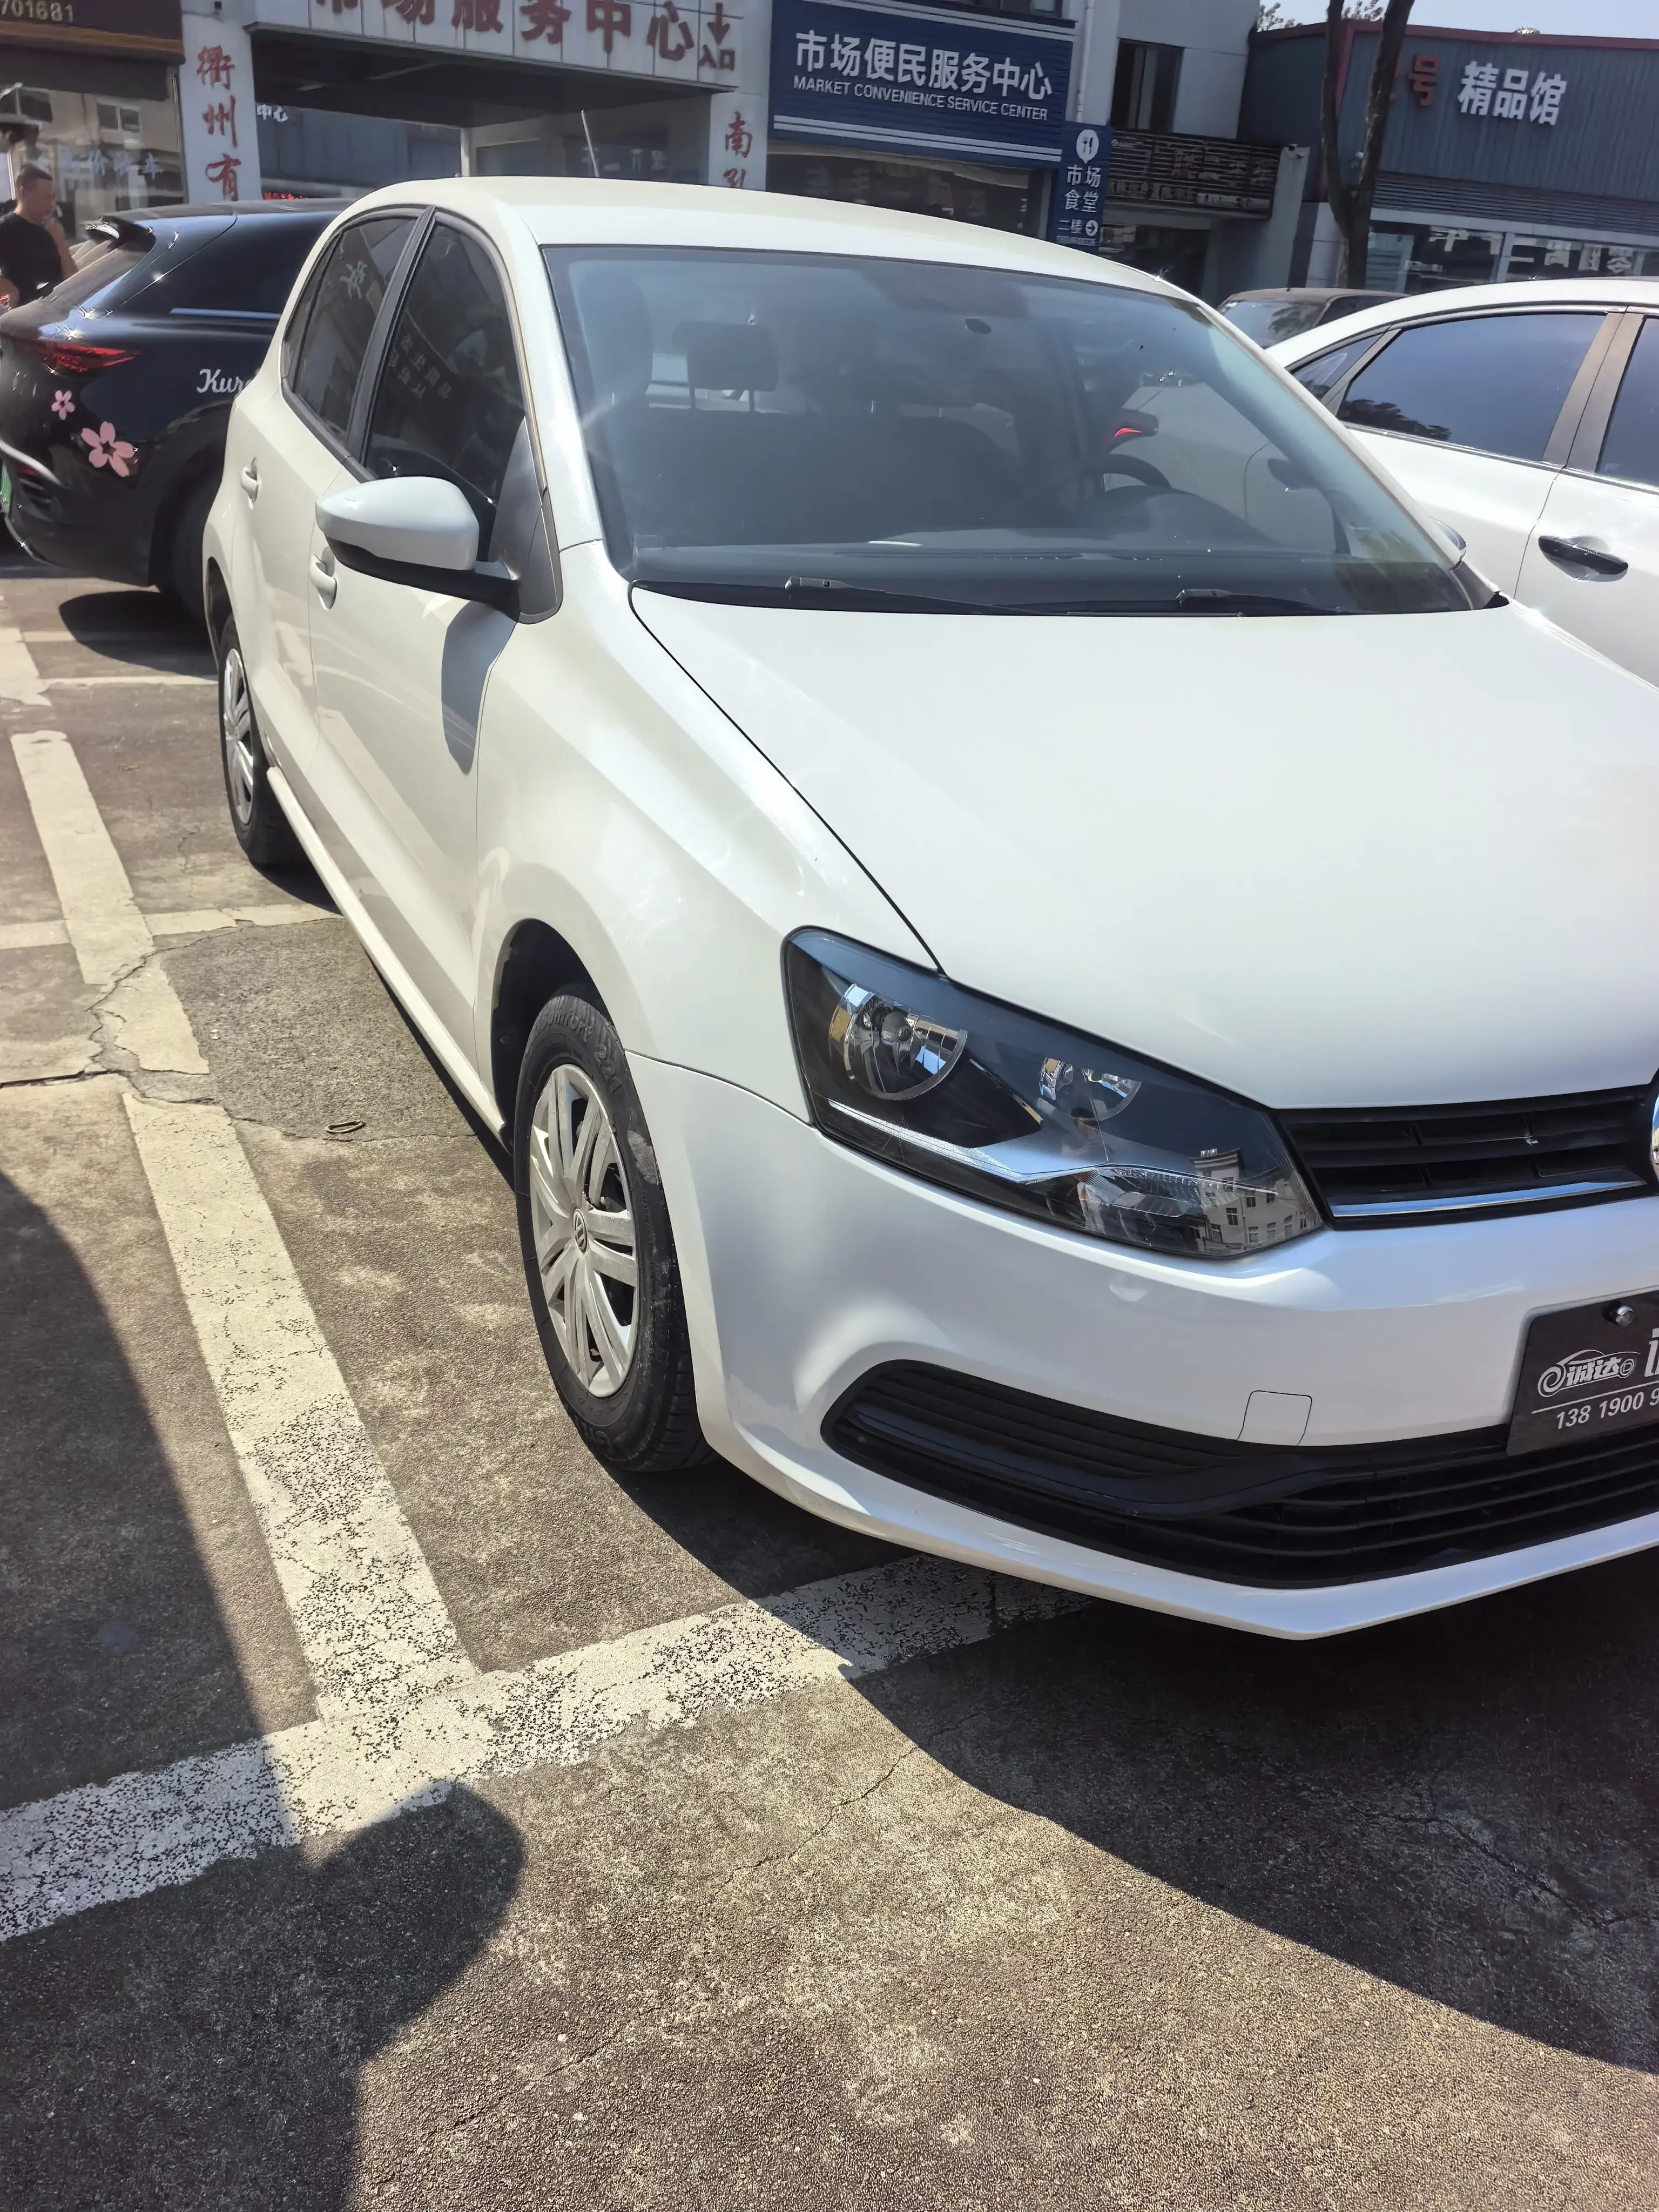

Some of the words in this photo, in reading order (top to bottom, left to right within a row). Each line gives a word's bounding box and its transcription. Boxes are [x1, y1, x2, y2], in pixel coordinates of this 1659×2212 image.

[699, 44, 736, 71] 入口
[795, 29, 1053, 100] 市场便民服务中心
[793, 75, 852, 96] MARKET
[854, 83, 946, 107] CONVENIENCE
[947, 95, 999, 114] SERVICE
[1001, 103, 1048, 121] CENTER
[1458, 60, 1568, 126] 精品馆
[1067, 164, 1102, 187] 市场
[1064, 189, 1098, 213] 食堂
[1556, 1404, 1591, 1429] 138
[1599, 1392, 1644, 1419] 1900
